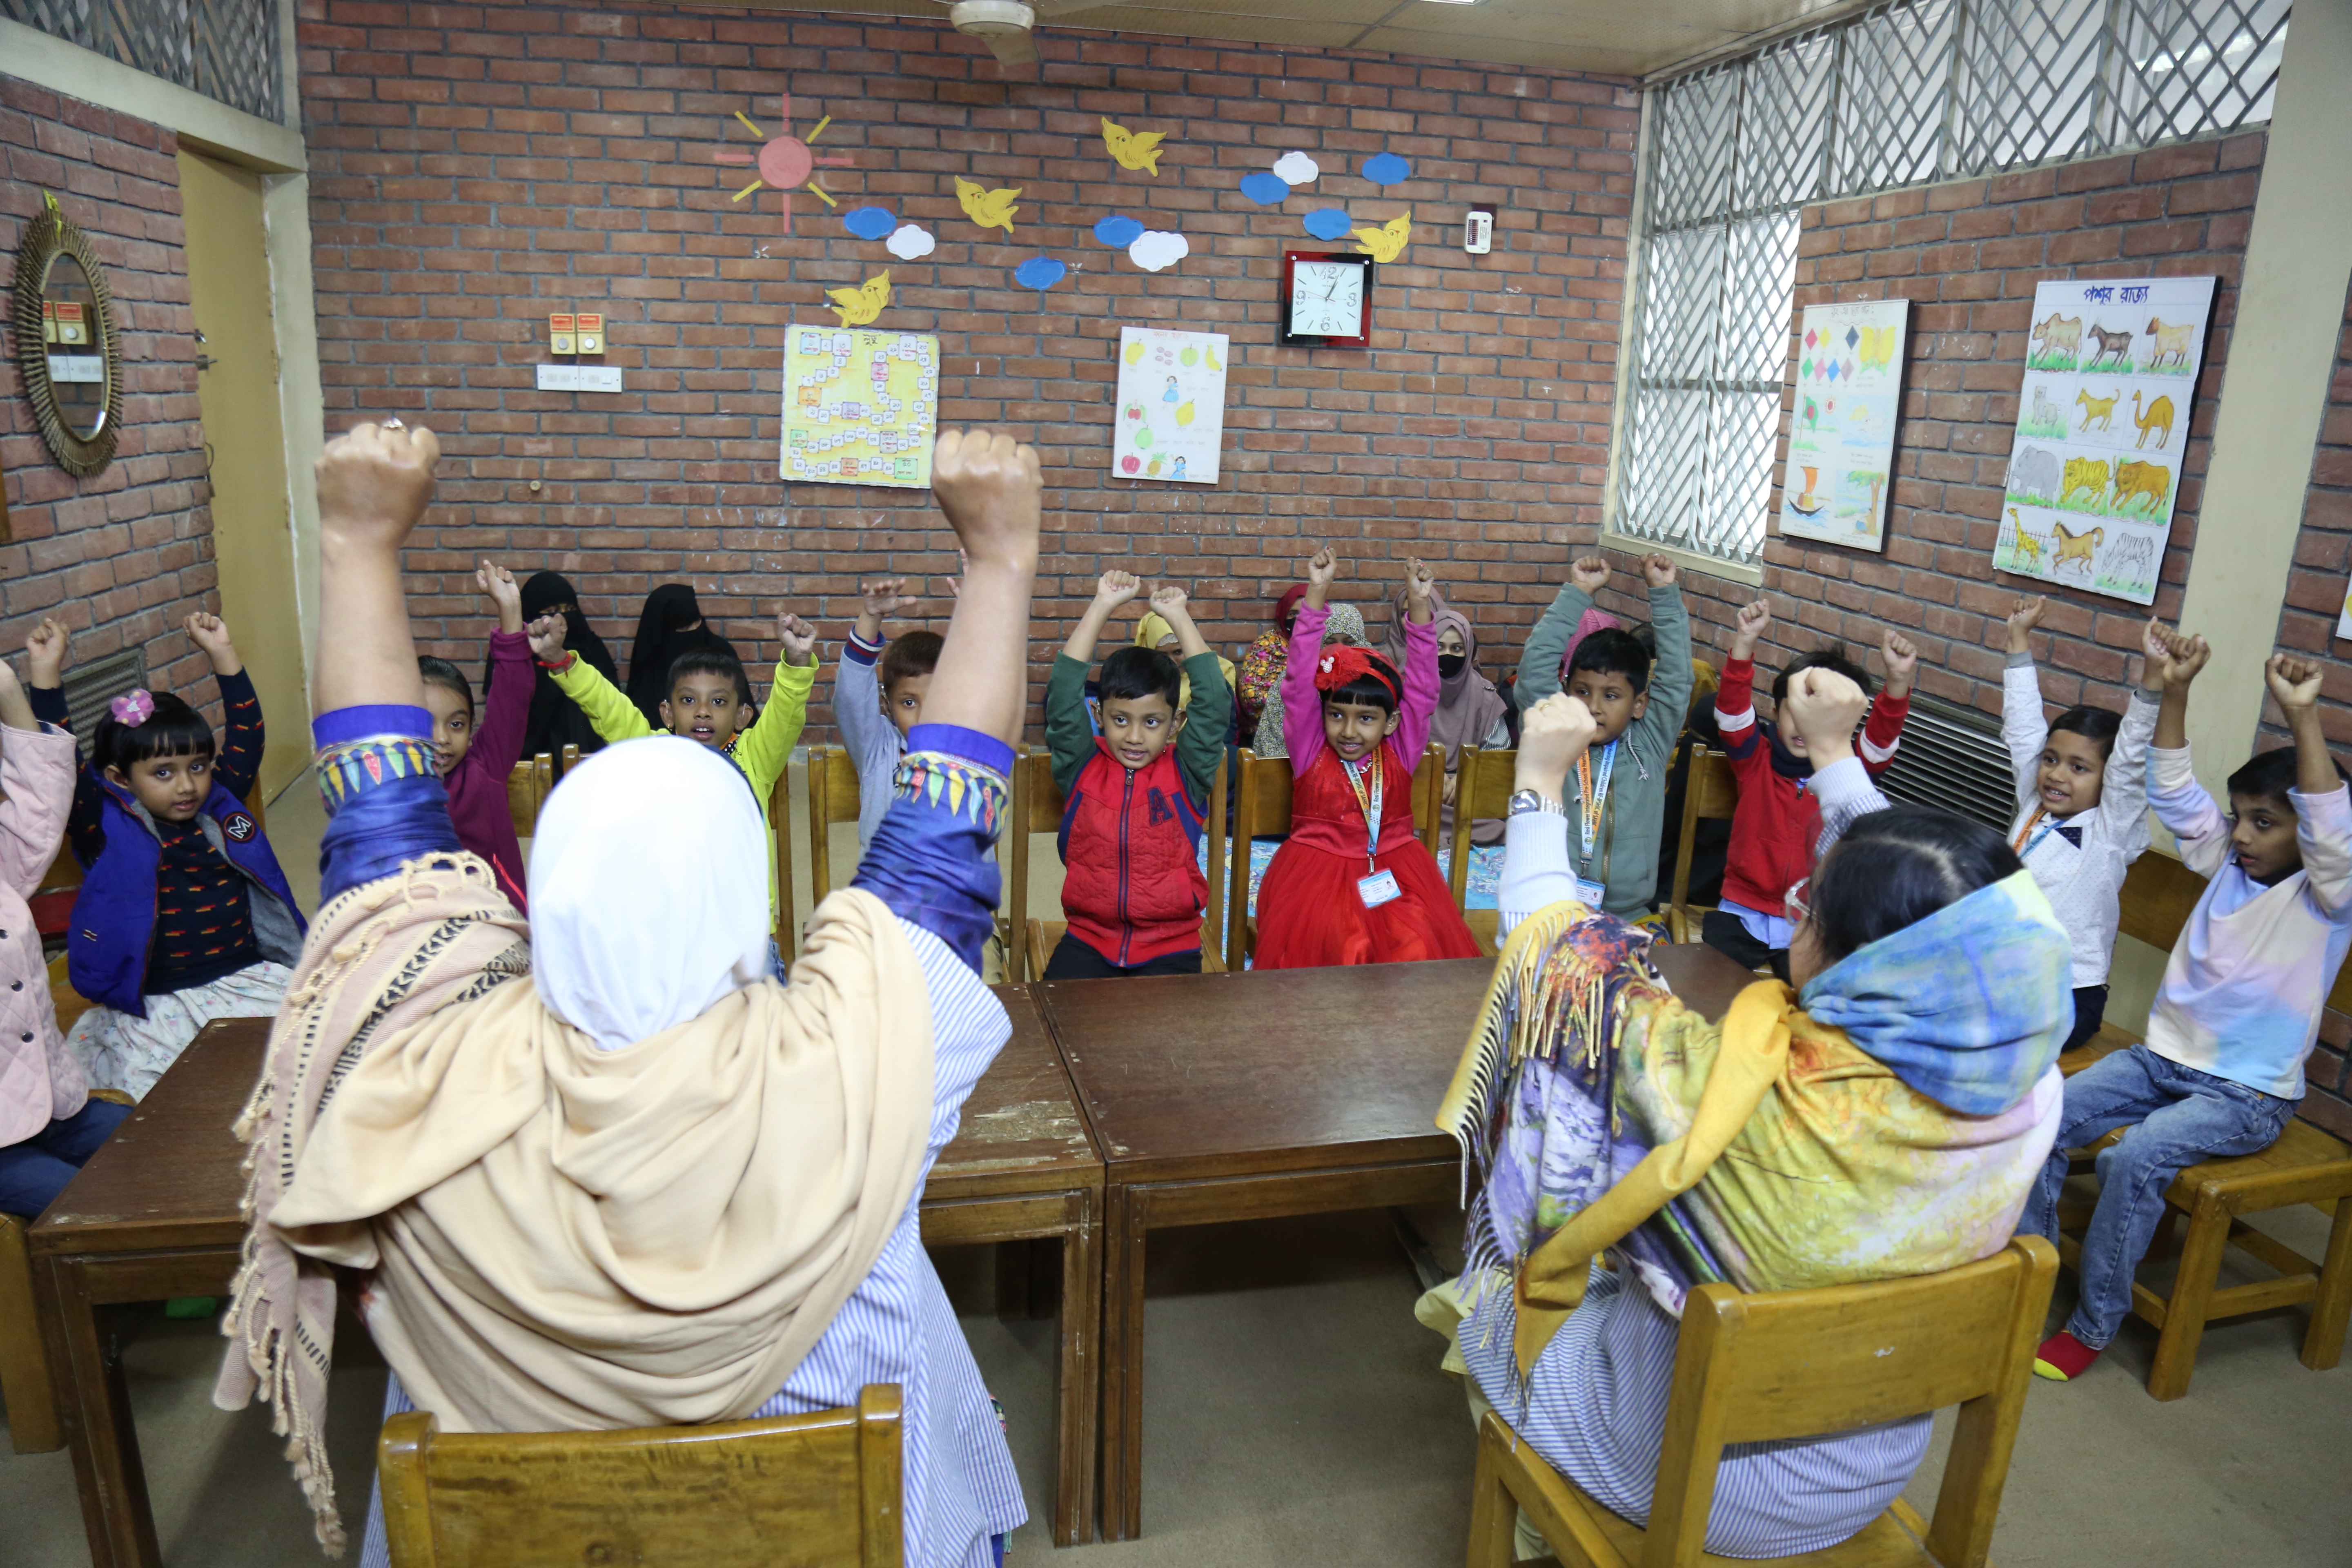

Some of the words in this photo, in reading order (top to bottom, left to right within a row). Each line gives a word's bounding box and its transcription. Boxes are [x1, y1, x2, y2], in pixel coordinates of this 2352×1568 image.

[1320, 266, 1337, 280] 12
[1296, 290, 1306, 305] 9
[1347, 292, 1357, 307] 3
[2120, 286, 2149, 304] রাজ্য
[1320, 316, 1330, 332] 6
[1605, 748, 1613, 760] Hearing
[1602, 760, 1610, 777] Impaired
[1599, 777, 1607, 792] Children
[1147, 786, 1175, 827] A
[228, 816, 252, 839] M
